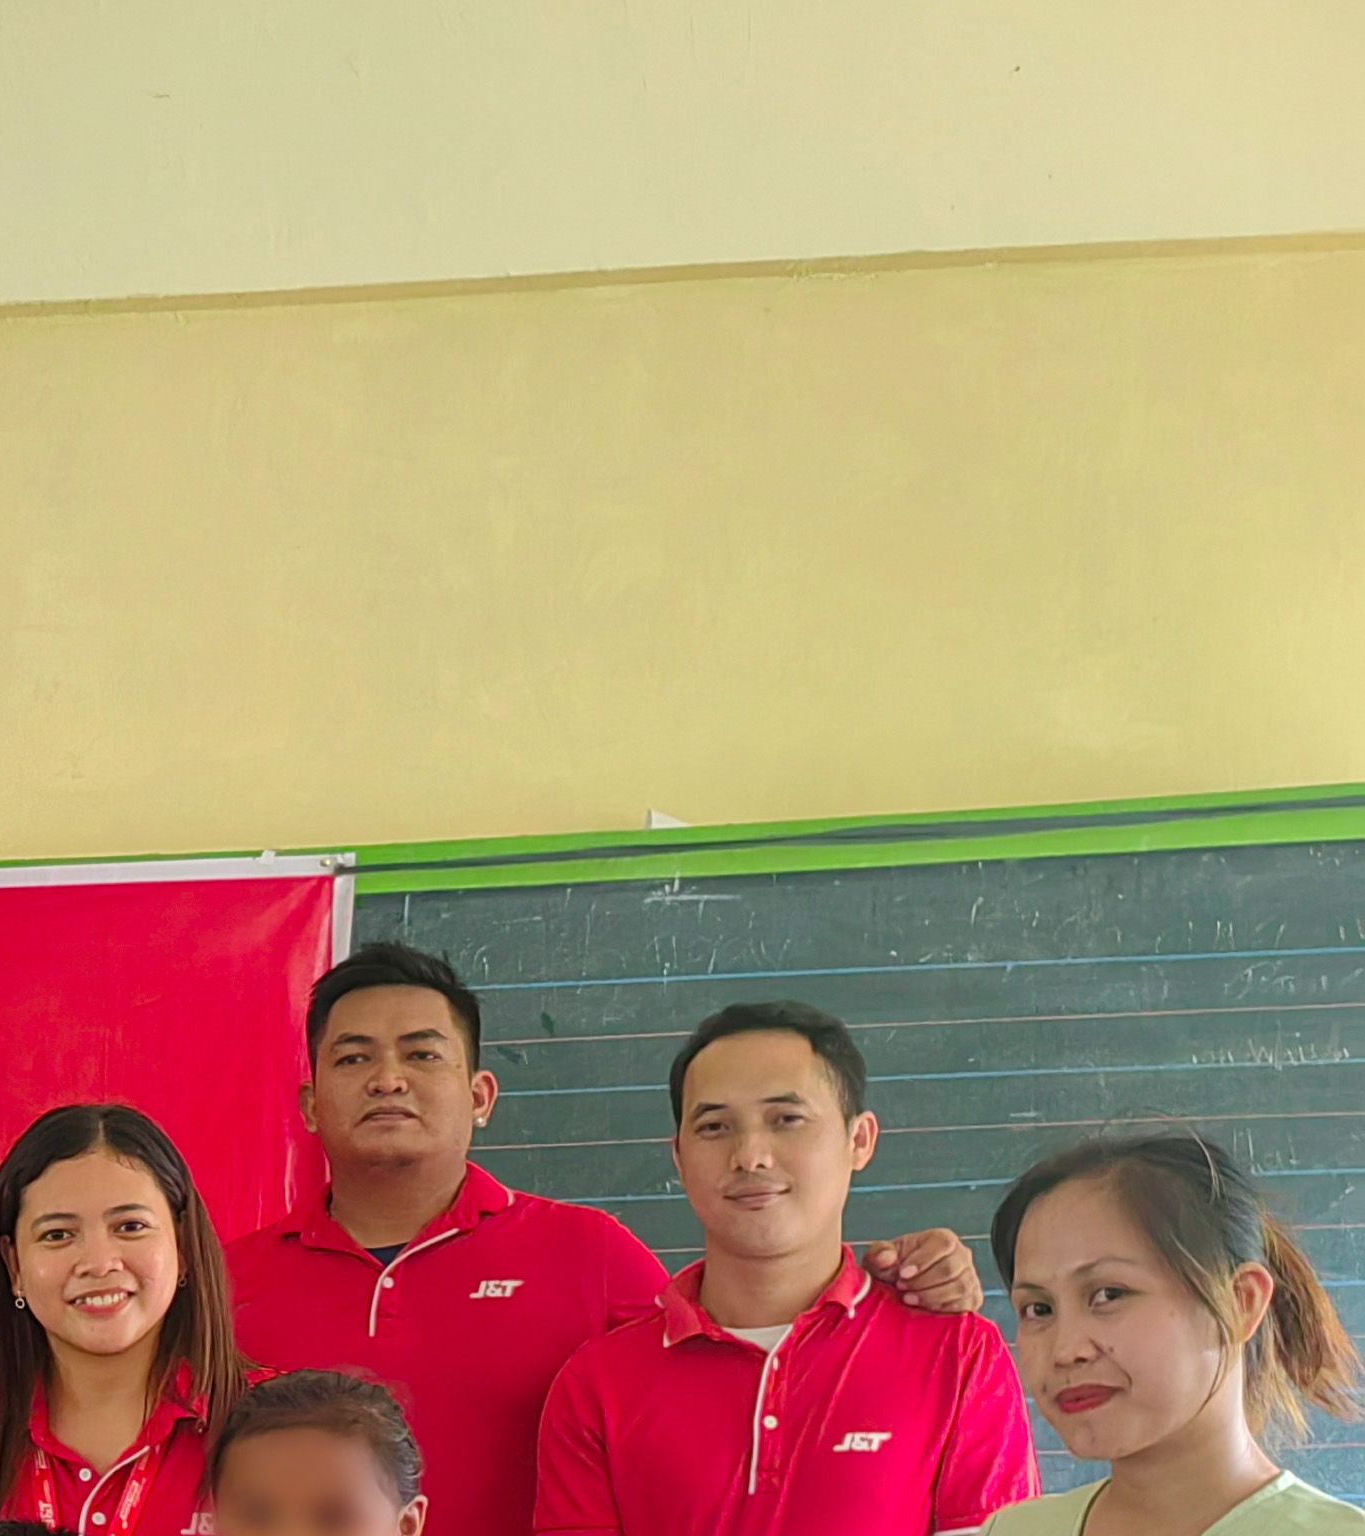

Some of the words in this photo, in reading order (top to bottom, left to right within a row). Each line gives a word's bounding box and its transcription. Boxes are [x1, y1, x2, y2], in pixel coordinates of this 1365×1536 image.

[470, 1279, 524, 1299] J&T
[833, 1431, 892, 1452] J&T
[181, 1512, 215, 1535] J&
